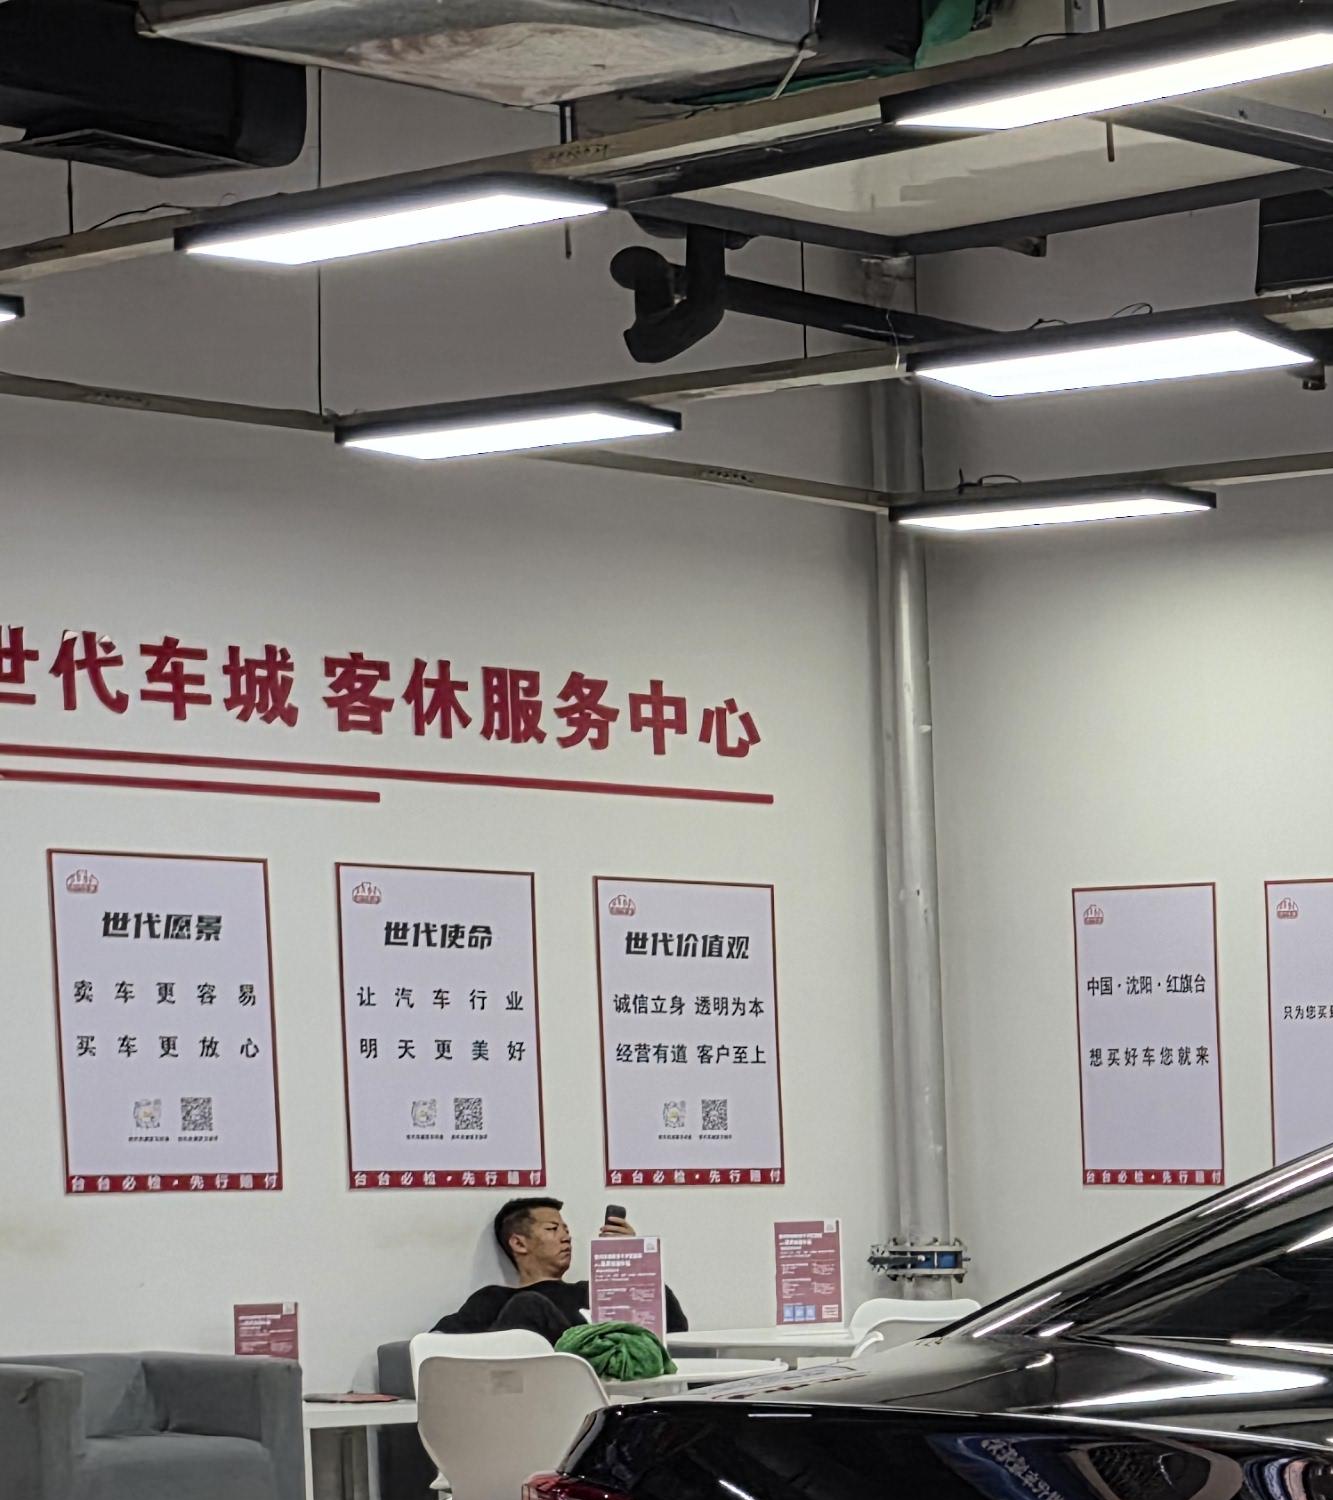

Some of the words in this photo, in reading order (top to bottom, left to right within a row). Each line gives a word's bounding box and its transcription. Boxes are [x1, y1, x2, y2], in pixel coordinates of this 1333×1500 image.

[323, 651, 762, 758] 客休服务中心
[101, 911, 223, 941] 世代愿景
[384, 921, 492, 949] 世代使命
[625, 931, 750, 959] 世代价值观
[73, 979, 256, 1007] 卖车更容易
[356, 986, 524, 1011] 让汽车行业
[613, 993, 686, 1015] 诚信立身
[694, 996, 765, 1018] 透明为本
[76, 1034, 260, 1059] 买车更放心
[360, 1038, 526, 1062] 明天更美好
[616, 1043, 688, 1064] 经营有道
[696, 1045, 767, 1065] 客户至上
[1089, 1046, 1210, 1067] 想买好车您就来
